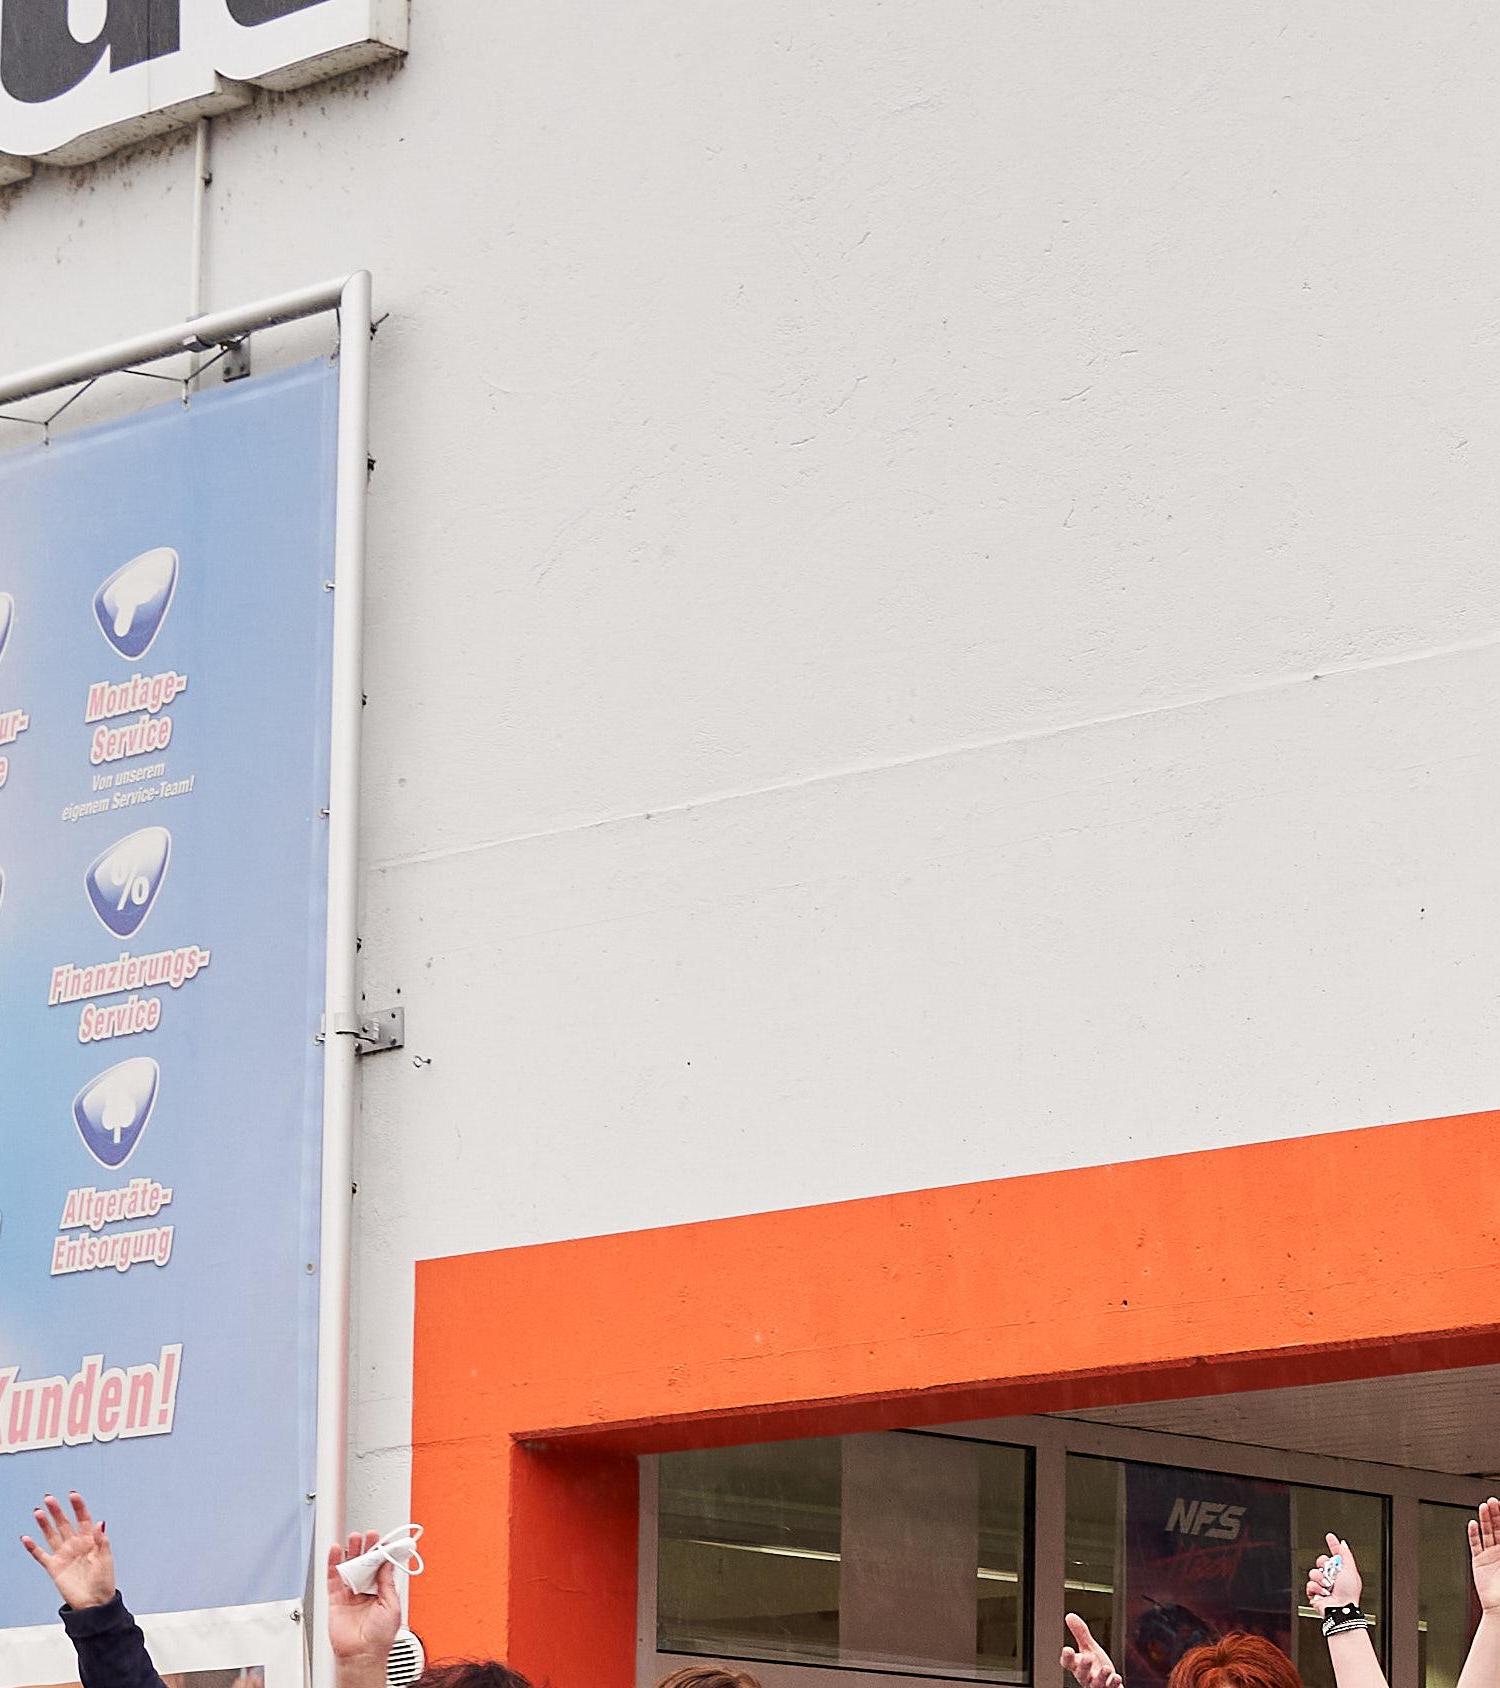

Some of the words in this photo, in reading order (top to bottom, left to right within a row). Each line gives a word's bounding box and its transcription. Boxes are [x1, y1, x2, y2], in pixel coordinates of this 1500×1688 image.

[86, 671, 187, 721] Montage-
[91, 717, 171, 764] Service
[61, 793, 111, 822] eigenem
[111, 775, 195, 810] Service-Team!
[91, 774, 113, 792] Von
[115, 763, 165, 787] unserem
[50, 946, 210, 1003] Finanzierungs-
[79, 997, 161, 1041] Service
[61, 1179, 171, 1229] Altgeräte-
[53, 1227, 172, 1274] Entsorgung
[1164, 1497, 1249, 1541] NFS
